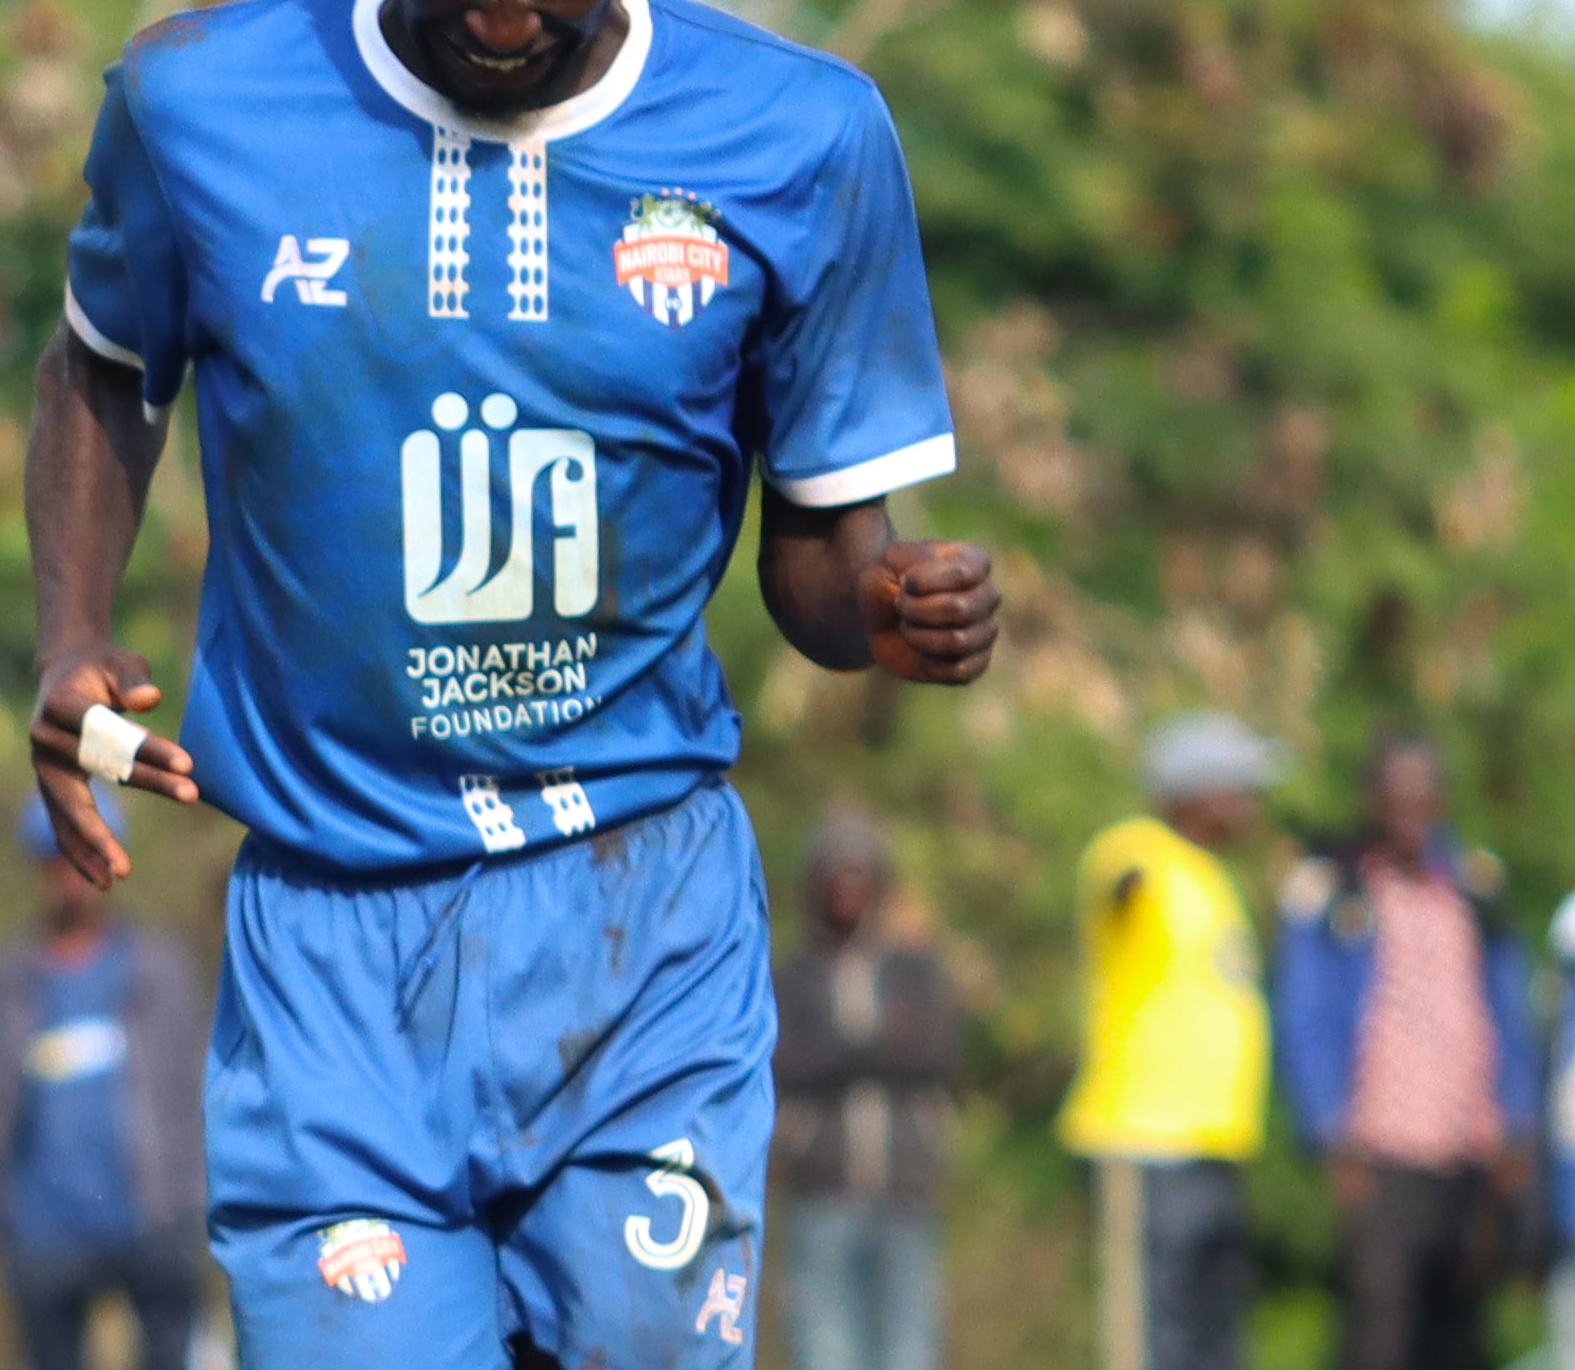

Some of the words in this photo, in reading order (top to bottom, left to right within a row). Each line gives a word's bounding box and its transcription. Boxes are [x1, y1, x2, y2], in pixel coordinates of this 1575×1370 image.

[619, 242, 684, 273] NAIROBI
[687, 242, 721, 273] CITY
[406, 632, 597, 678] JONATHAN
[421, 662, 586, 708] JACKSON
